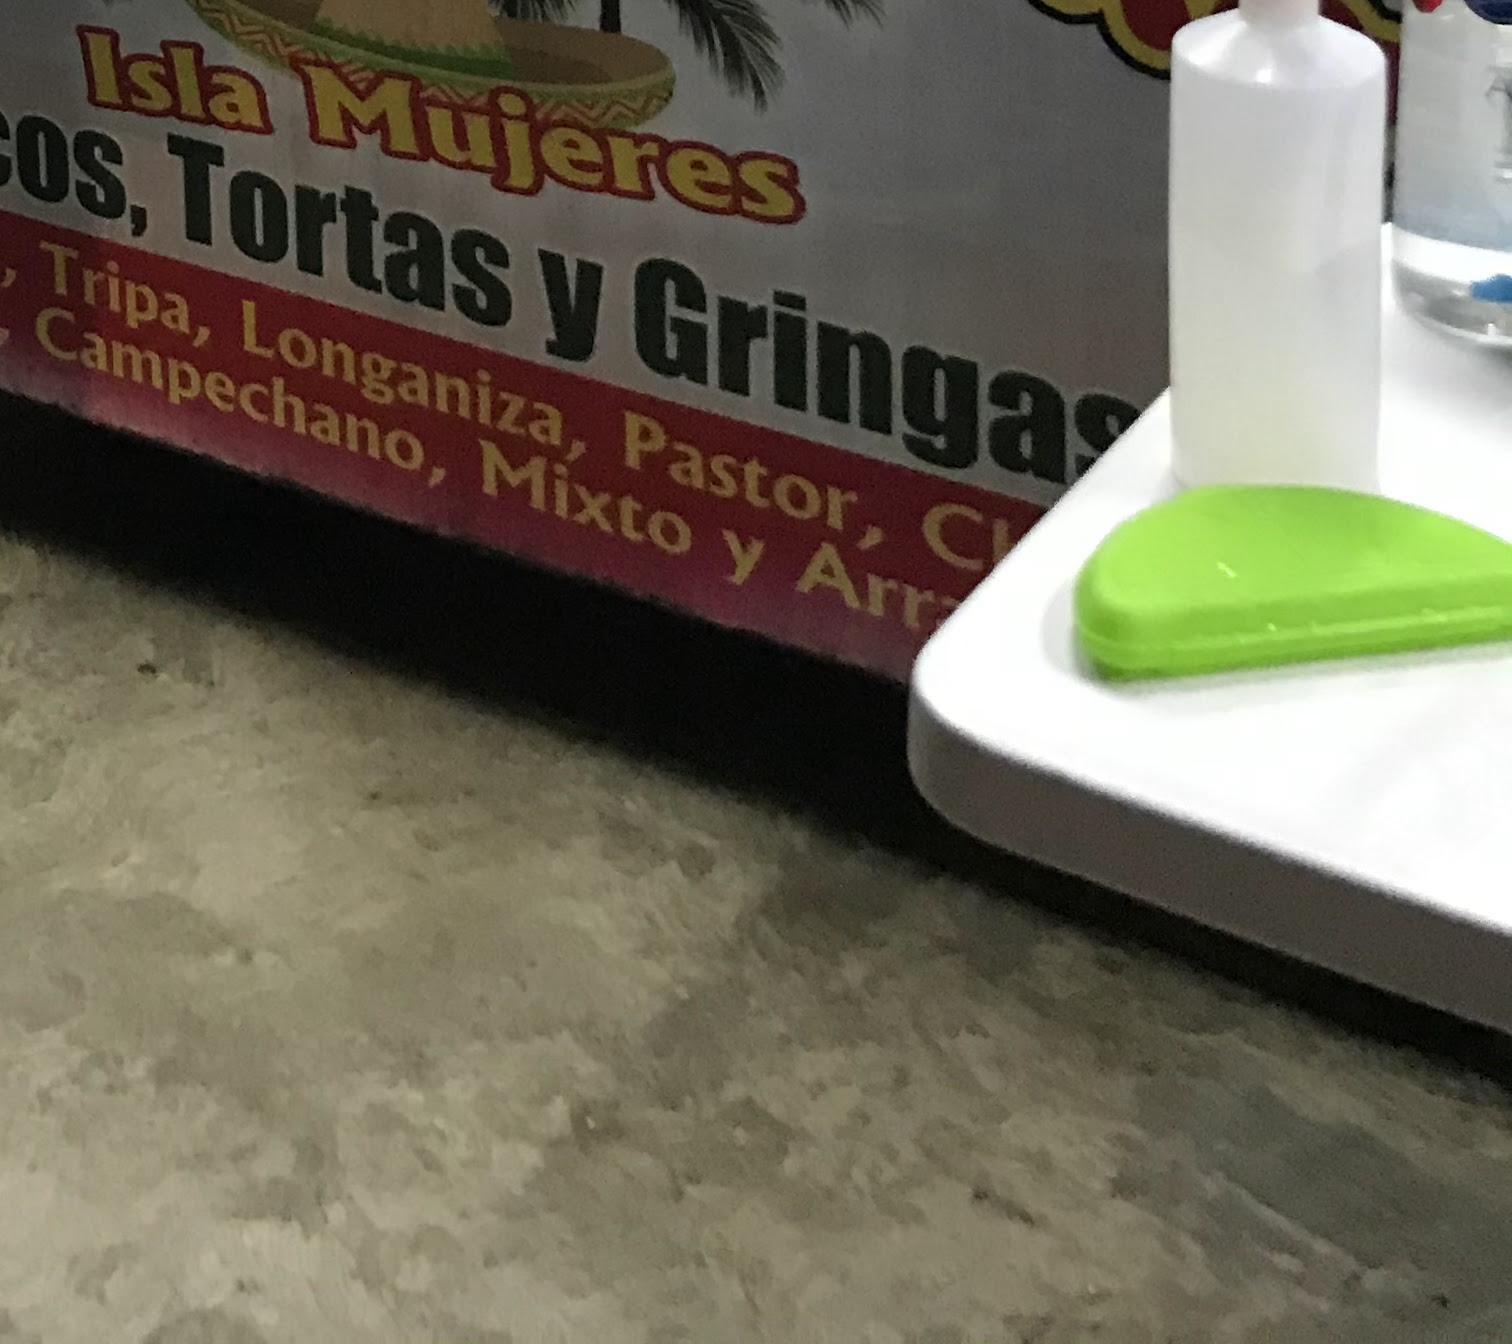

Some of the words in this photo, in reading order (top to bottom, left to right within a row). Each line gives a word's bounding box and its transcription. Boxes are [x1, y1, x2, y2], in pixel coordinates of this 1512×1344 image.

[77, 25, 274, 134] Isla
[296, 57, 806, 224] Mujeres
[167, 132, 512, 326] Tortas
[538, 248, 603, 362] y
[34, 307, 448, 488] Campechano,
[479, 440, 693, 555] Mixto
[720, 528, 766, 585] y
[795, 541, 962, 631] Arr
[39, 238, 210, 348] Tripa,
[242, 299, 586, 464] Longaniza,
[622, 412, 884, 550] Pastor,
